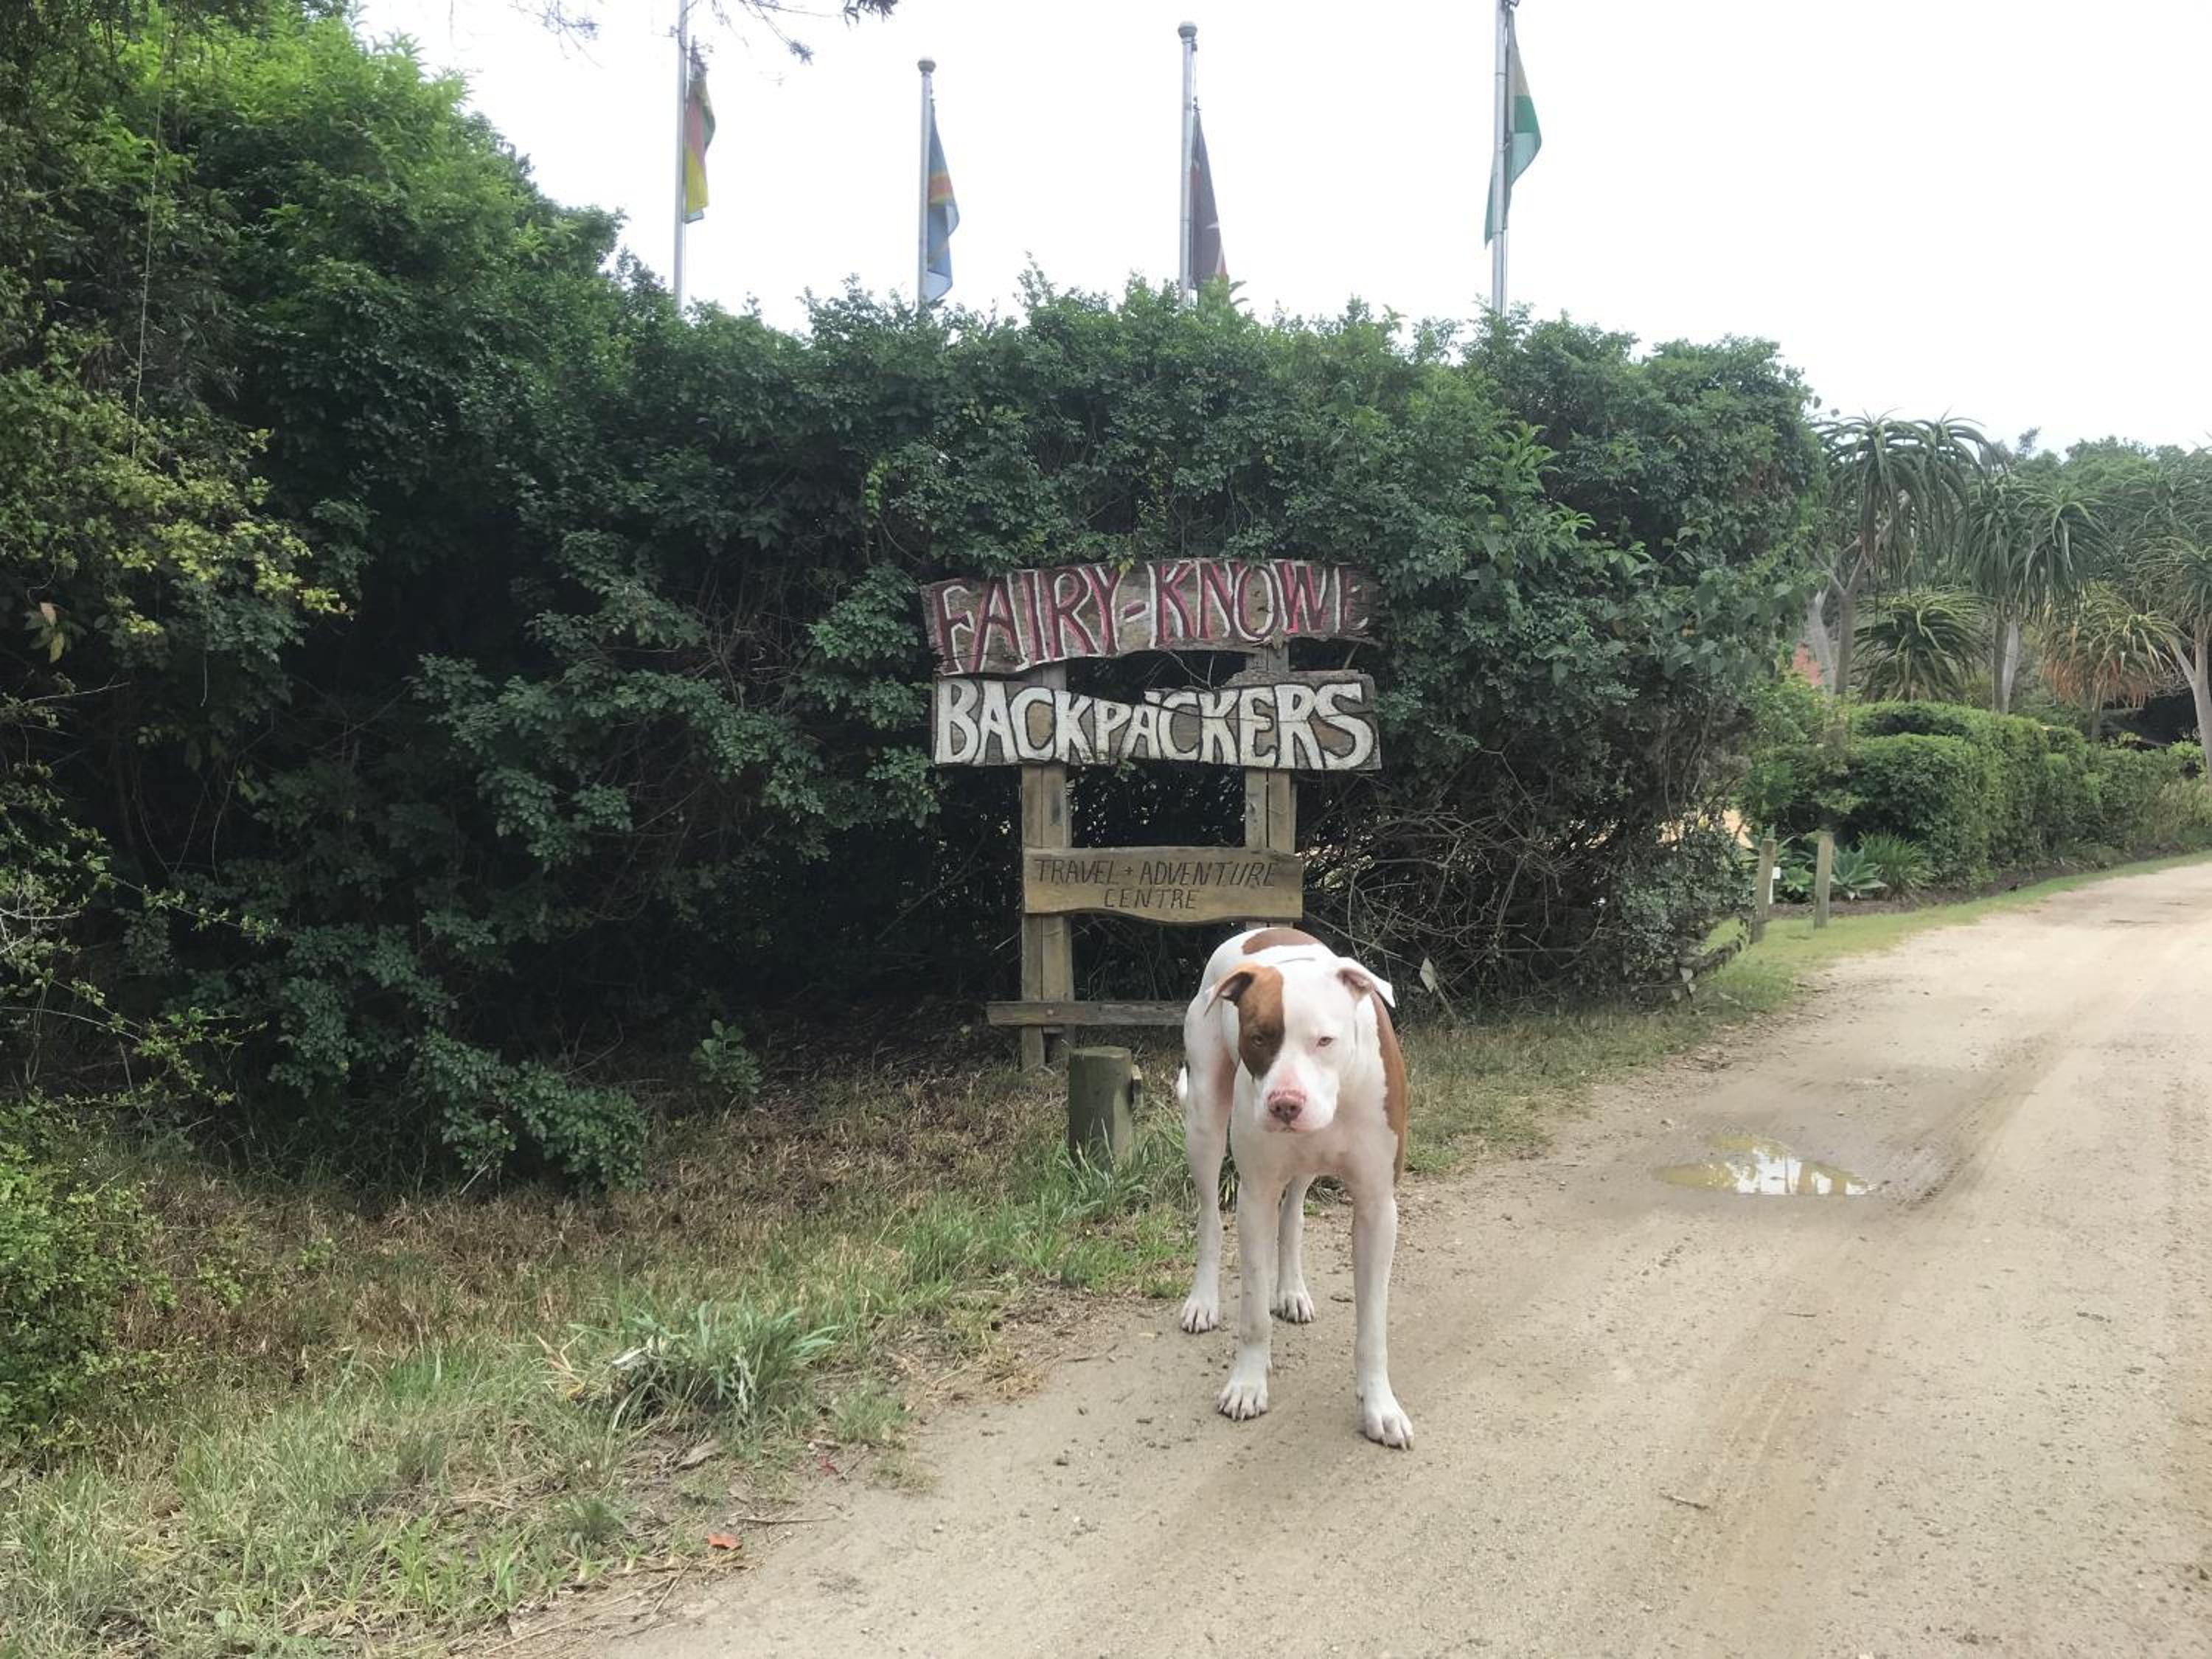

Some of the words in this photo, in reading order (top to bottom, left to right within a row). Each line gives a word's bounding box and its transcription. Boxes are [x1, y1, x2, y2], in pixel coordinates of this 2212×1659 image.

[933, 559, 1369, 675] FAIRY-KNOWE
[934, 680, 1374, 769] BACKPACKERS
[1034, 859, 1121, 885] TRAVEL
[1140, 860, 1279, 888] ADVENTURE
[1105, 888, 1200, 909] CENTRE
